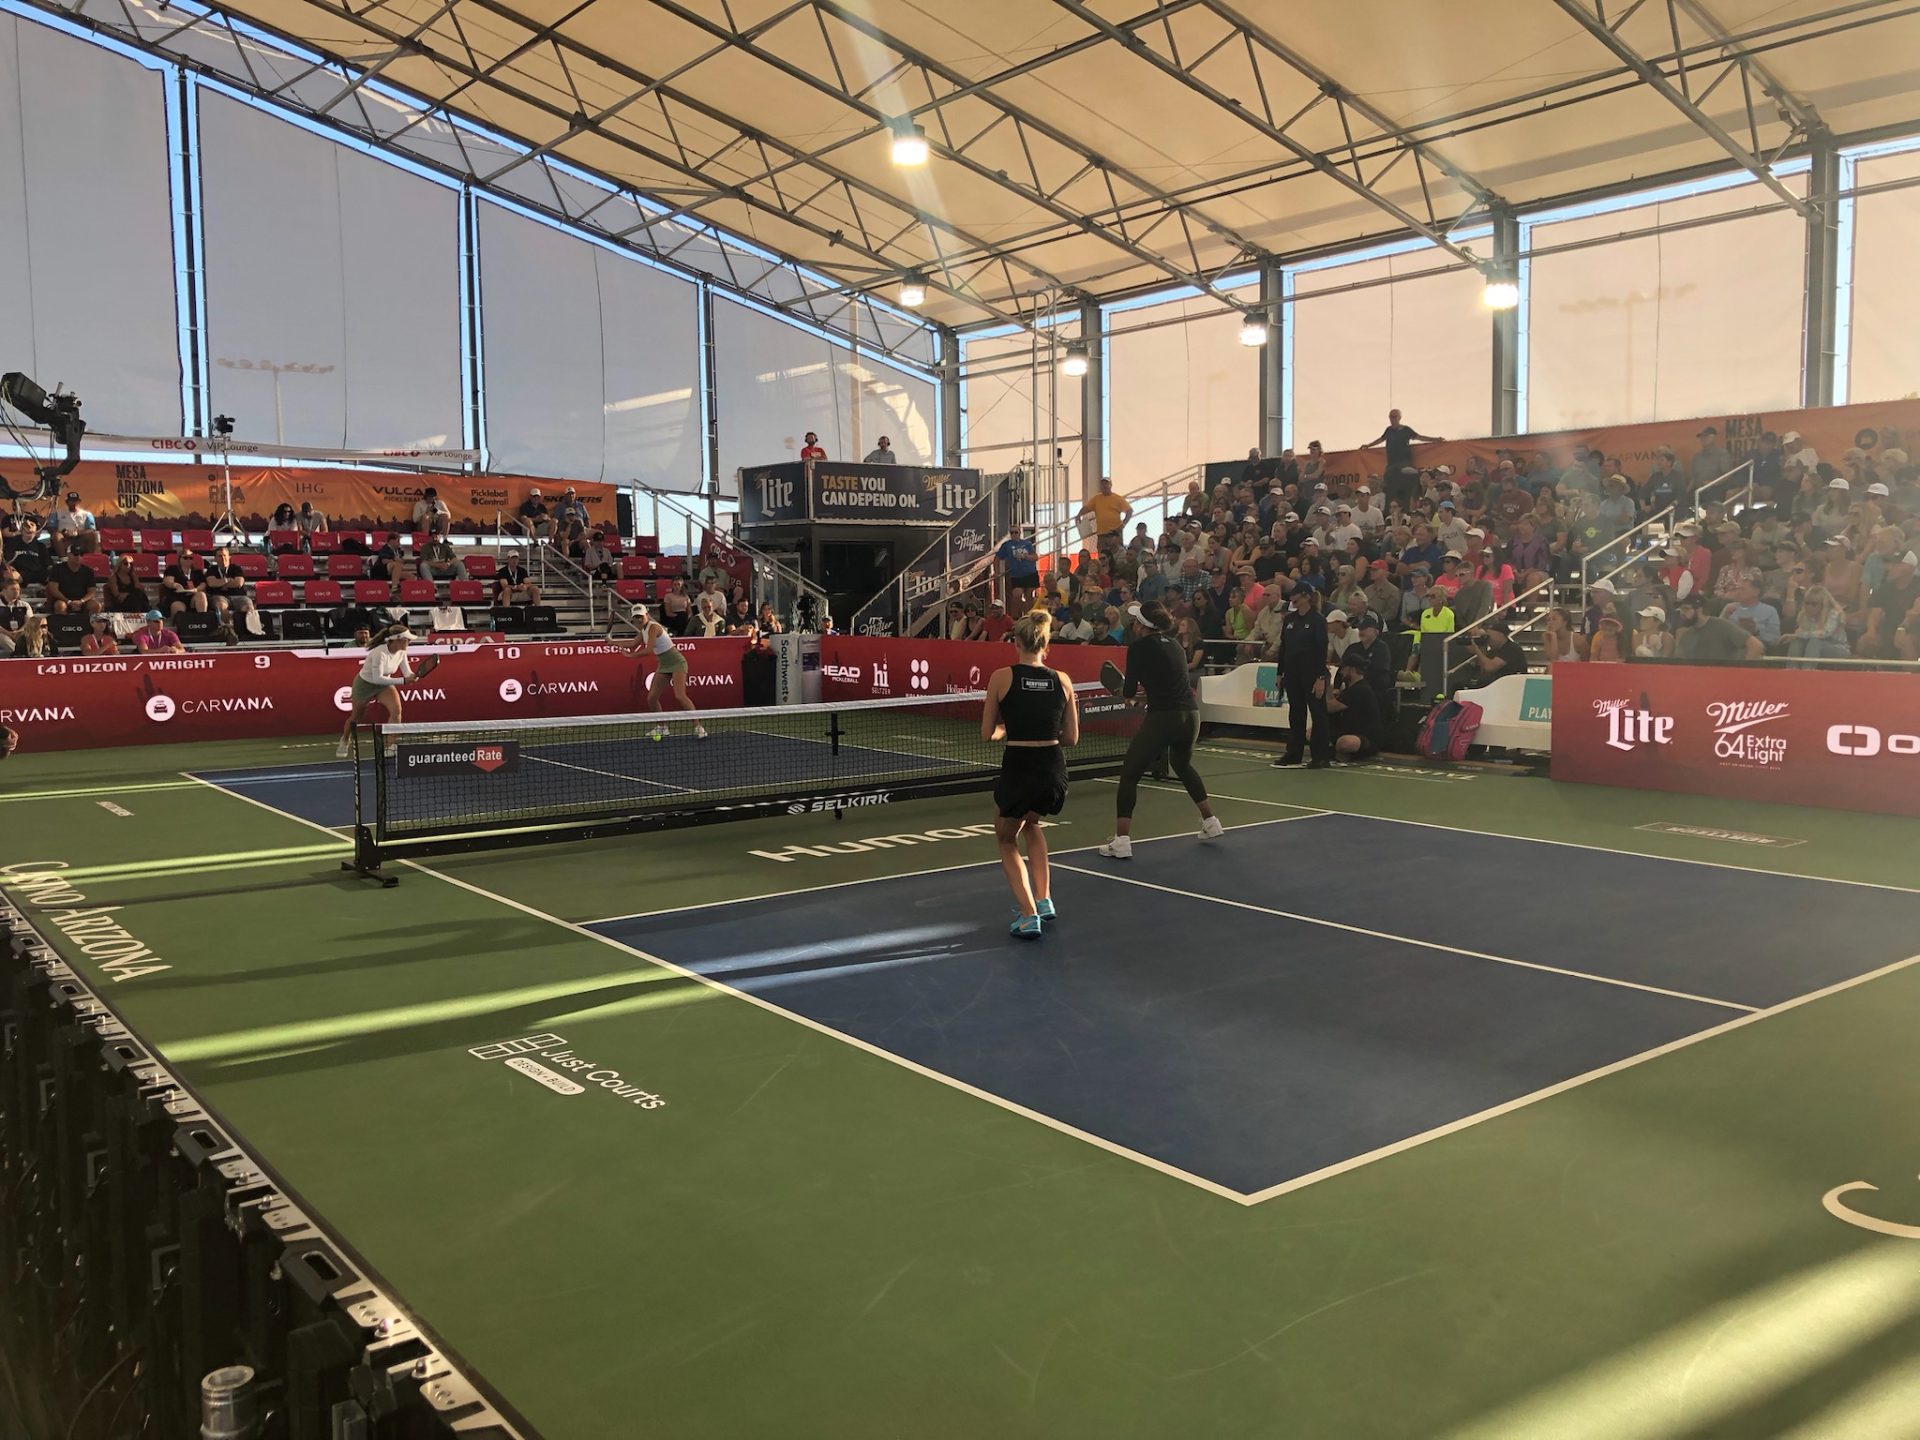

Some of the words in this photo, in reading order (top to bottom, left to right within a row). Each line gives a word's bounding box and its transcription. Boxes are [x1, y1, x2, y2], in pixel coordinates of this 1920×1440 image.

[1725, 416, 1763, 438] MESA
[152, 440, 182, 450] CIBC
[225, 443, 258, 452] Lounge
[444, 452, 472, 460] Lounge
[116, 464, 147, 480] MESA
[117, 480, 164, 495] ARIZONA
[296, 482, 324, 494] IHG
[372, 486, 424, 496] VULCA
[821, 475, 858, 490] TASTE
[860, 477, 886, 492] YOU
[470, 489, 508, 497] Pickleball
[760, 478, 794, 518] Lite
[822, 491, 847, 506] CAN
[849, 492, 896, 508] DEPEND
[898, 494, 920, 508] ON.
[934, 483, 977, 516] Lite
[118, 495, 140, 508] CUP
[954, 534, 986, 551] Miller
[859, 622, 894, 636] Miller
[494, 647, 520, 660] 10
[578, 645, 631, 654] BRASC
[72, 662, 127, 674] DIZON
[133, 662, 144, 671] /
[149, 660, 216, 671] WRIGHT
[254, 655, 270, 669] 9
[781, 640, 790, 695] Southwest
[822, 665, 860, 678] HEAD
[873, 662, 889, 687] hi
[527, 680, 598, 696] CARVANA
[670, 674, 734, 687] RVANA
[872, 687, 891, 695] SELTZER
[946, 684, 968, 694] Holland
[182, 697, 274, 713] CARVANA
[1085, 706, 1100, 714] SAME
[1101, 704, 1113, 712] DAY
[1593, 699, 1630, 717] Miller
[1, 706, 75, 722] RVANA
[1706, 700, 1790, 727] Miller
[1606, 707, 1674, 752] Lite
[1714, 733, 1745, 758] 64
[1746, 734, 1787, 750] Extra
[1748, 748, 1784, 764] Light
[810, 794, 890, 813] SELKIRK
[747, 820, 1059, 863] Human
[41, 906, 173, 982] ARIZONA
[512, 1060, 543, 1076] DESIGN
[546, 1077, 576, 1092] BUILD
[540, 1050, 597, 1072] Just
[586, 1070, 665, 1110] Courts
